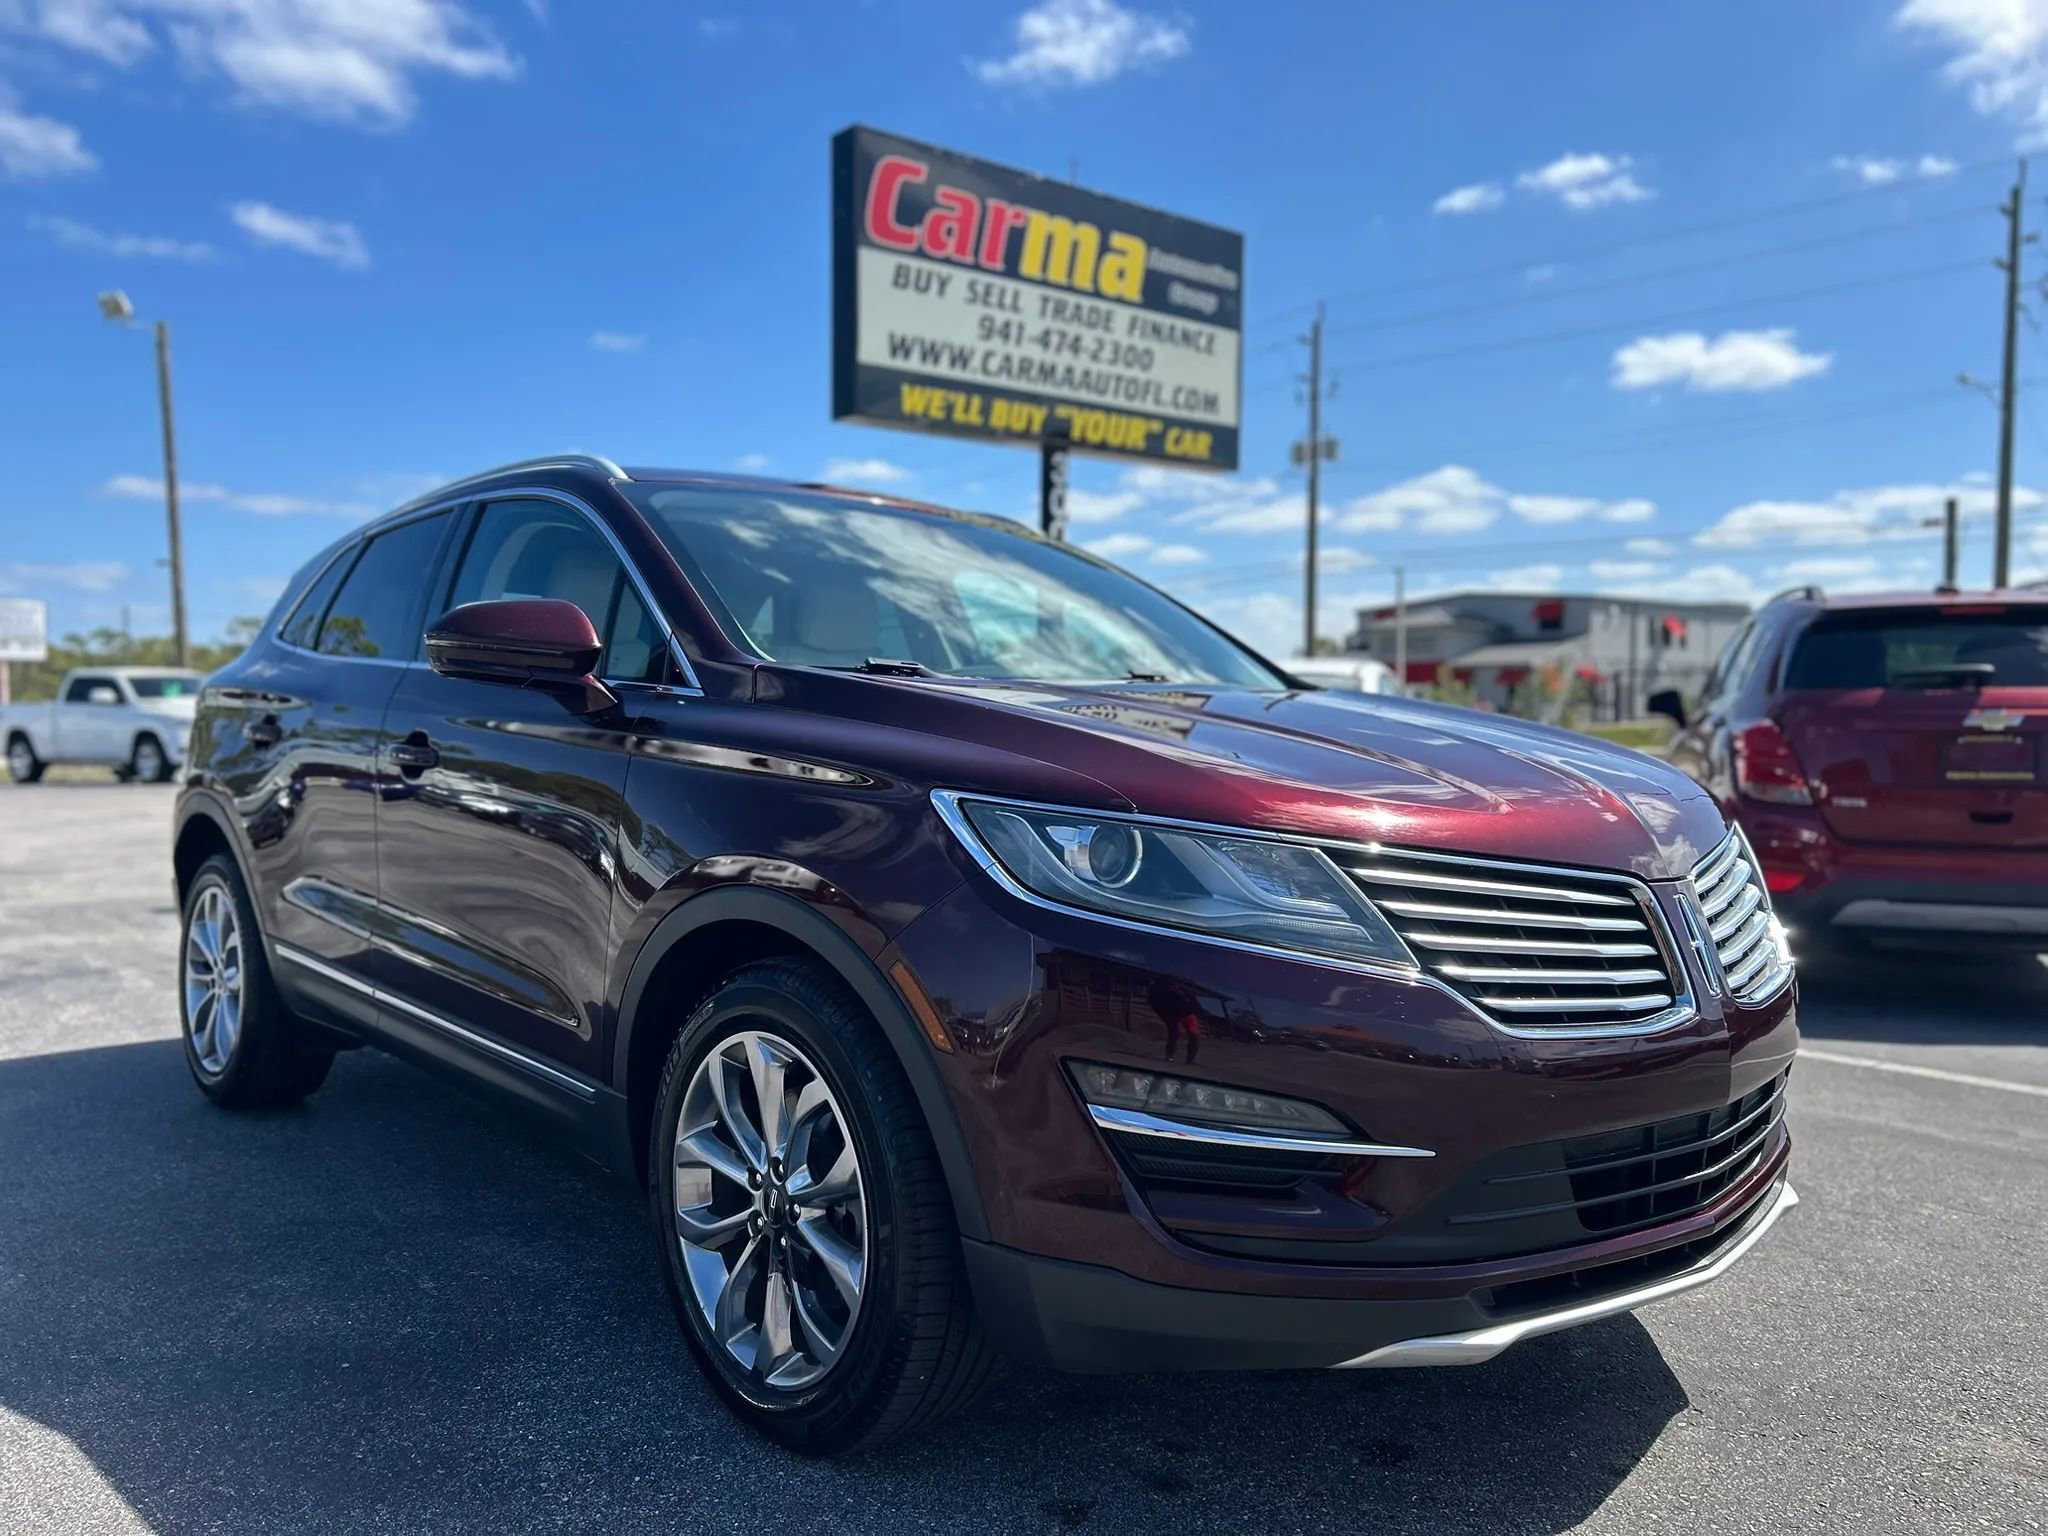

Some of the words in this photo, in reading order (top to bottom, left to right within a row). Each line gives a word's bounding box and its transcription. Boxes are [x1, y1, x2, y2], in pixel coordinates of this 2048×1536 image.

[865, 155, 1148, 303] Carma
[893, 263, 952, 298] BUY
[965, 278, 1022, 313] SELL
[1040, 294, 1115, 333] TRADE
[1127, 315, 1215, 356] FINANCE
[978, 313, 1155, 371] 941-474-2300
[888, 330, 1219, 414] WWW.CARMAAUTOFL.COM
[901, 383, 984, 425] WE'LL
[989, 398, 1047, 433] BUY
[1053, 403, 1163, 449] "YOUR"
[1165, 427, 1213, 459] CAR
